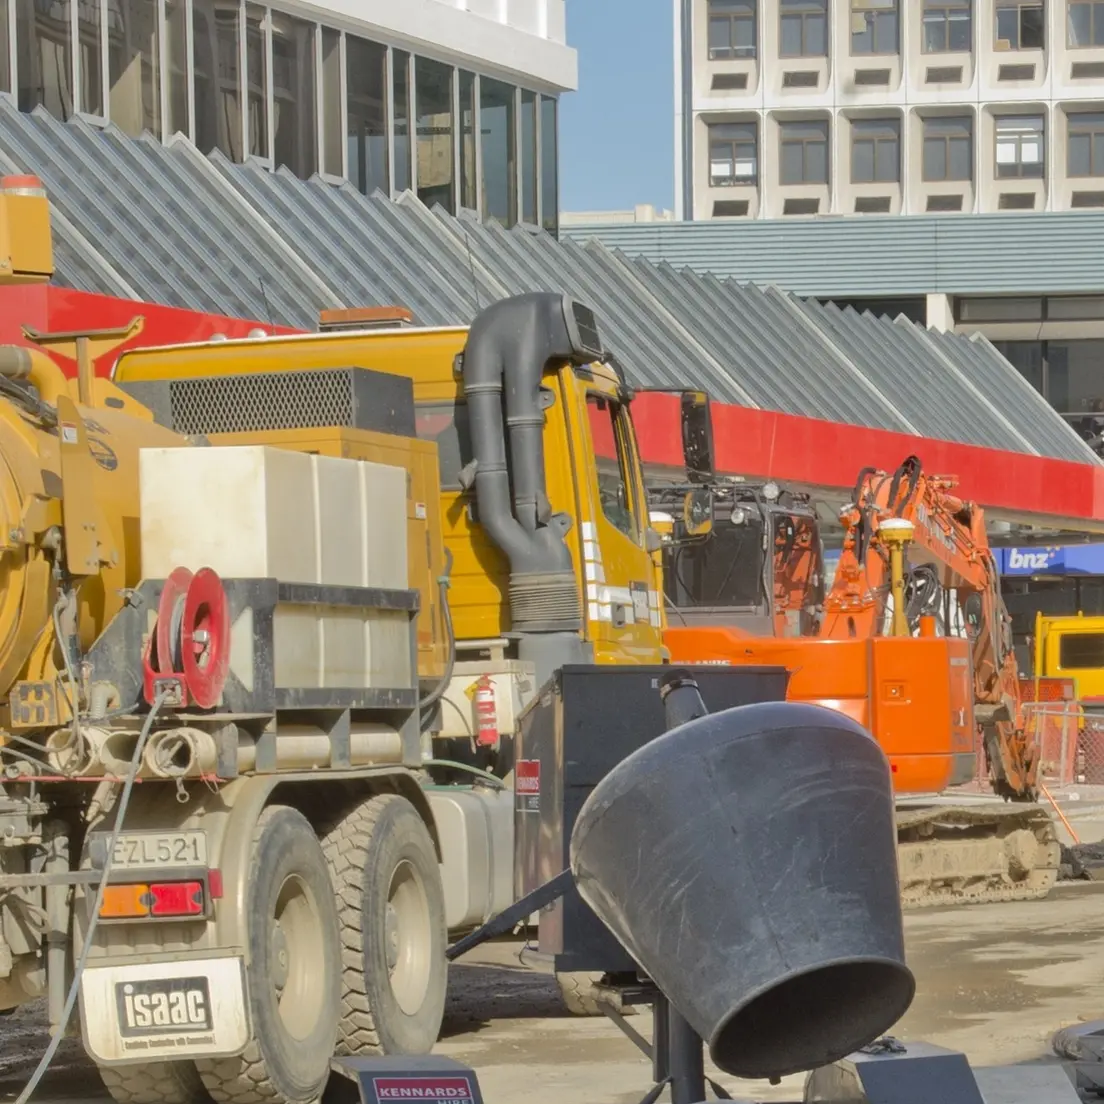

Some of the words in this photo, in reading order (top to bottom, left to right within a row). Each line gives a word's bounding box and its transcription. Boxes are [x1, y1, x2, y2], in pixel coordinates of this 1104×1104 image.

[1009, 547, 1049, 569] bnz
[111, 837, 201, 864] EZL521
[123, 983, 206, 1028] isaac
[379, 1087, 467, 1097] KENNARDS
